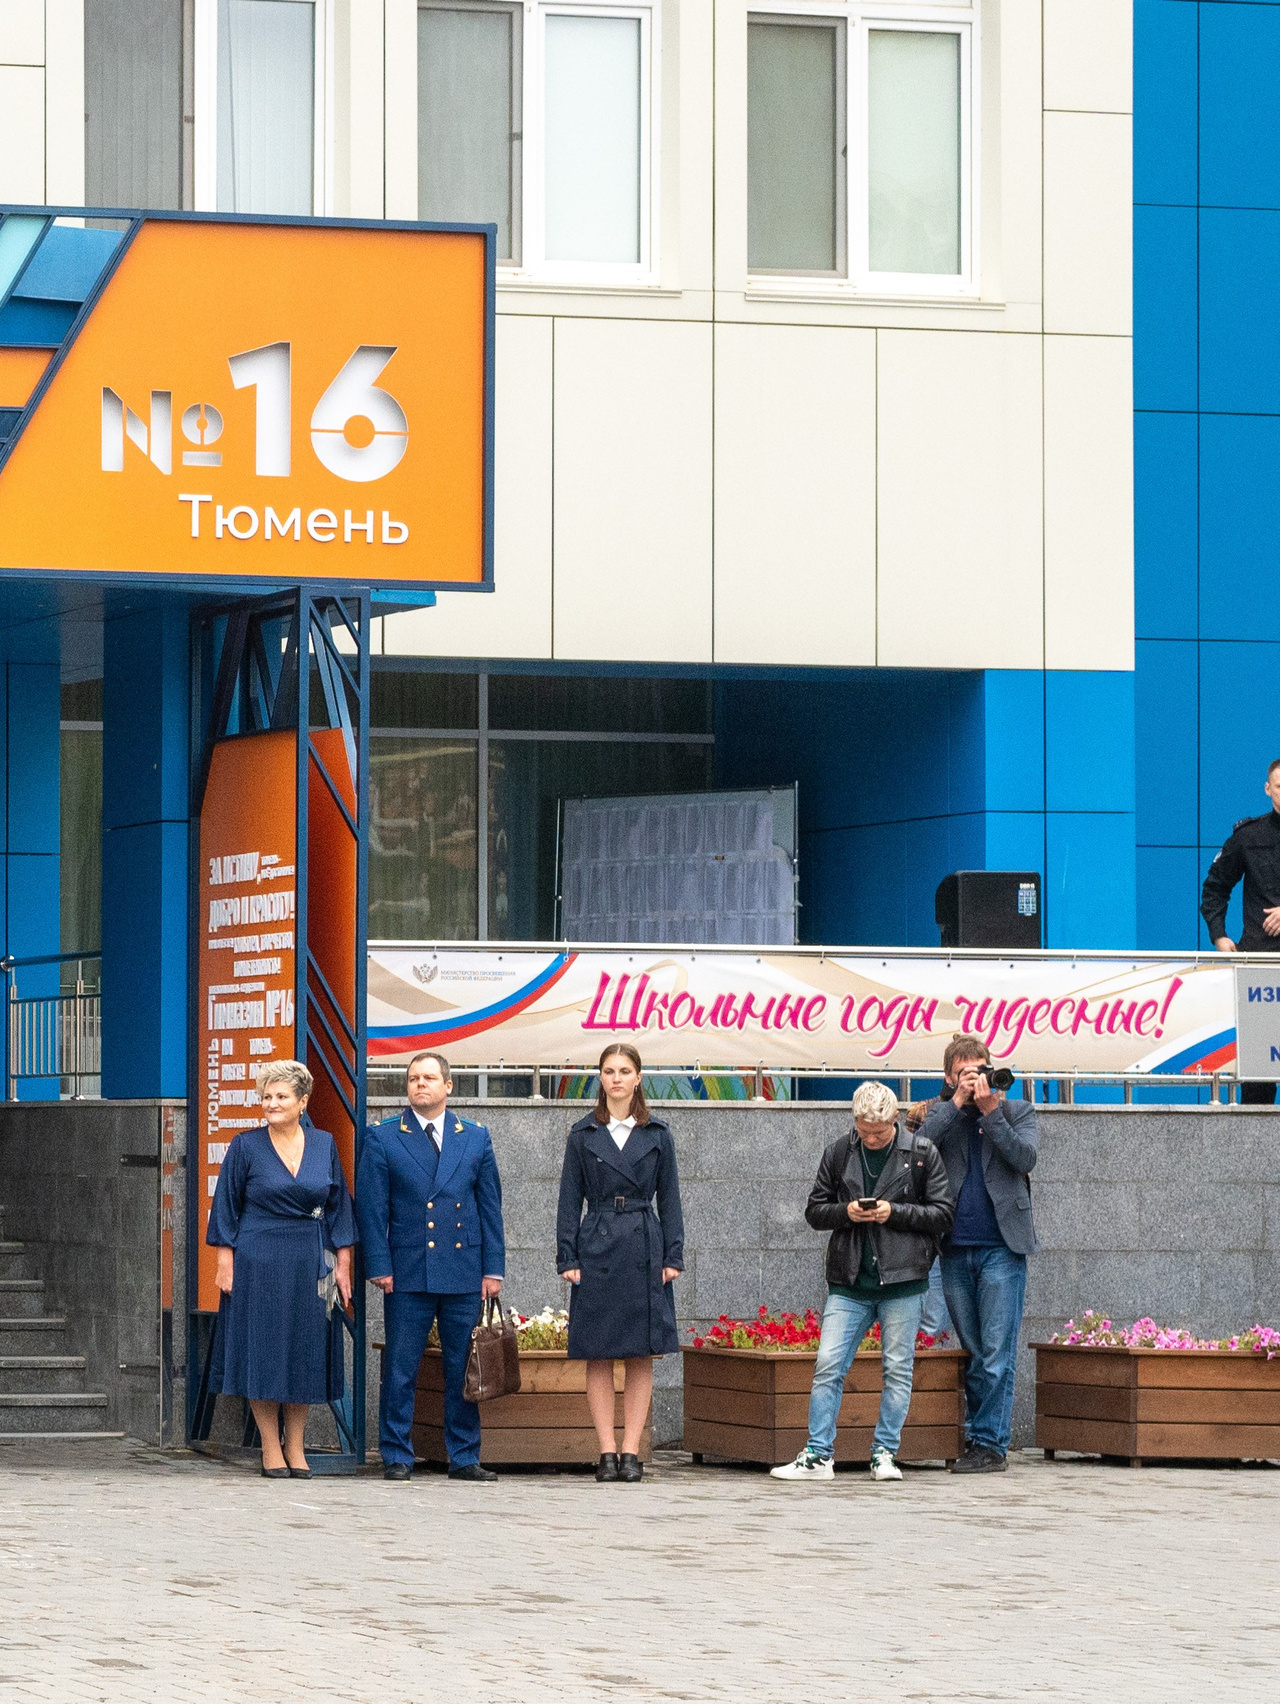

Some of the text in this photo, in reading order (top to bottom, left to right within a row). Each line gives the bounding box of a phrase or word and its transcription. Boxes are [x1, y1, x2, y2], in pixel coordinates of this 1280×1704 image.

[101, 341, 409, 482] №16
[178, 493, 410, 545] Тюмень
[249, 890, 295, 924] КРАСОТУ!
[581, 970, 1184, 1058] Школьные годы чудесные!
[207, 1037, 219, 1136] ТЮМЕНЬ
